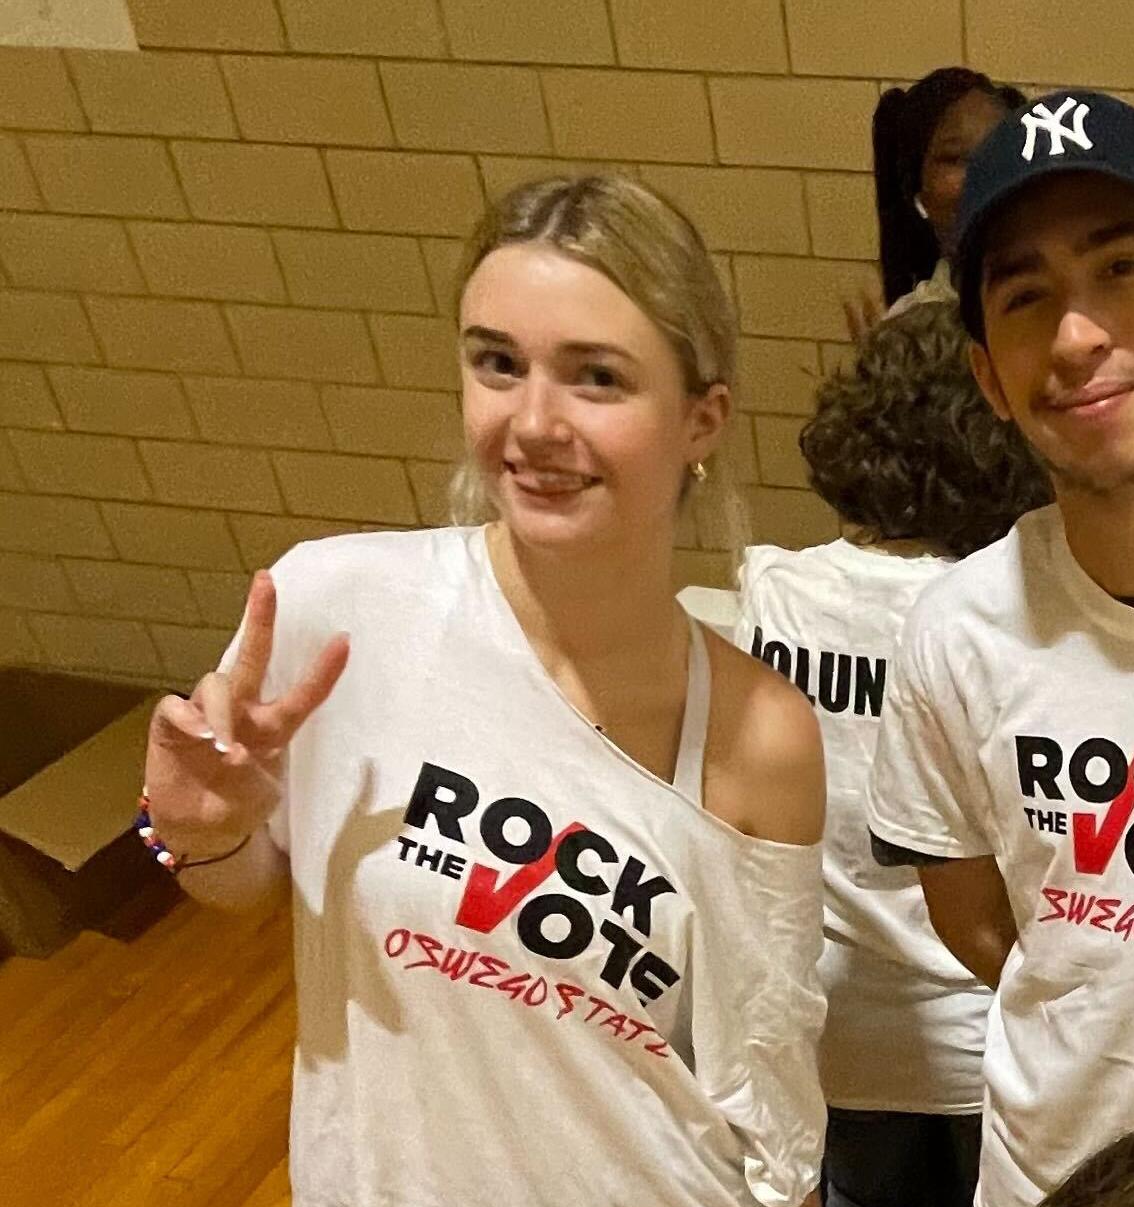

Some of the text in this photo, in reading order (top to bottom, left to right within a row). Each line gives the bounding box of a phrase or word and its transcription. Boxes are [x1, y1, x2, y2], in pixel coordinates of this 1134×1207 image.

[1021, 97, 1093, 161] NY
[403, 762, 678, 938] ROCK
[1023, 808, 1067, 835] THE
[397, 822, 681, 1008] THE VOTE
[384, 928, 548, 1007] OSWEGO
